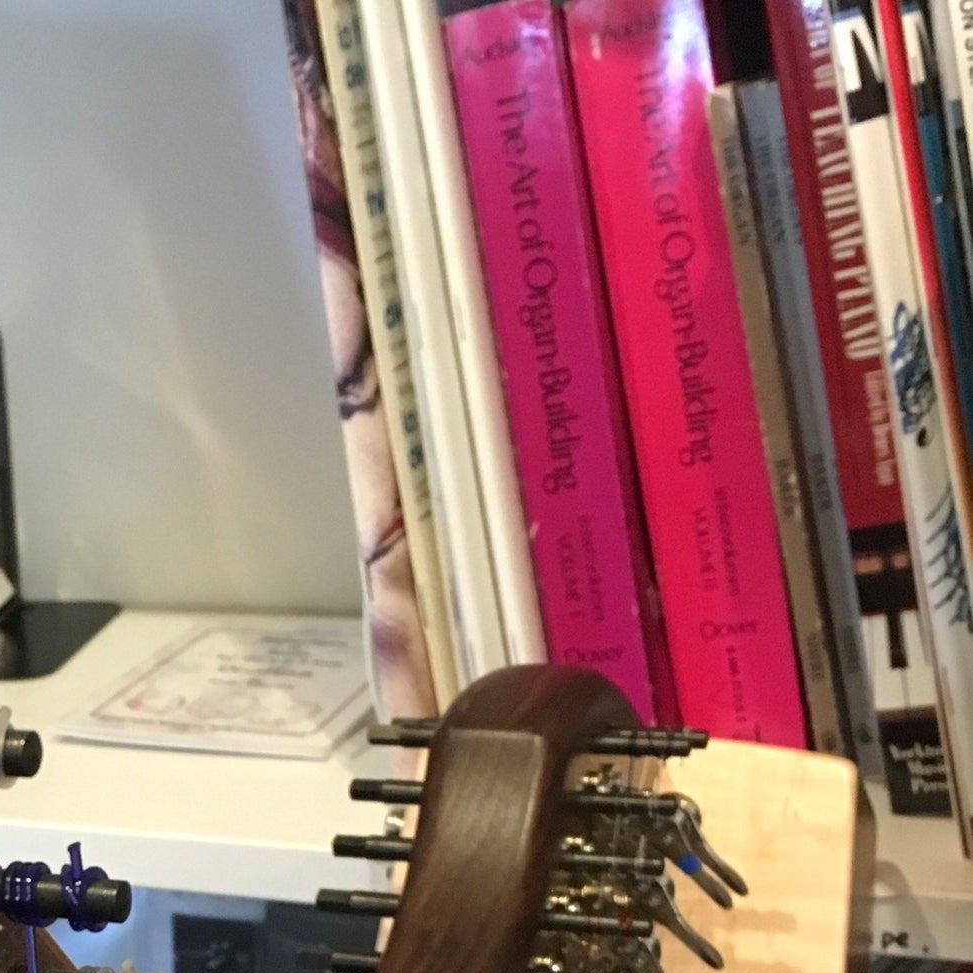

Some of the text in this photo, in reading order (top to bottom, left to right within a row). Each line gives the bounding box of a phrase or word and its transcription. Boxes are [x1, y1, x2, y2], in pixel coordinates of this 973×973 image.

[647, 138, 681, 190] Art
[653, 191, 688, 227] of
[496, 90, 580, 496] The Art of Organ-Building
[654, 230, 721, 470] Organ-Building
